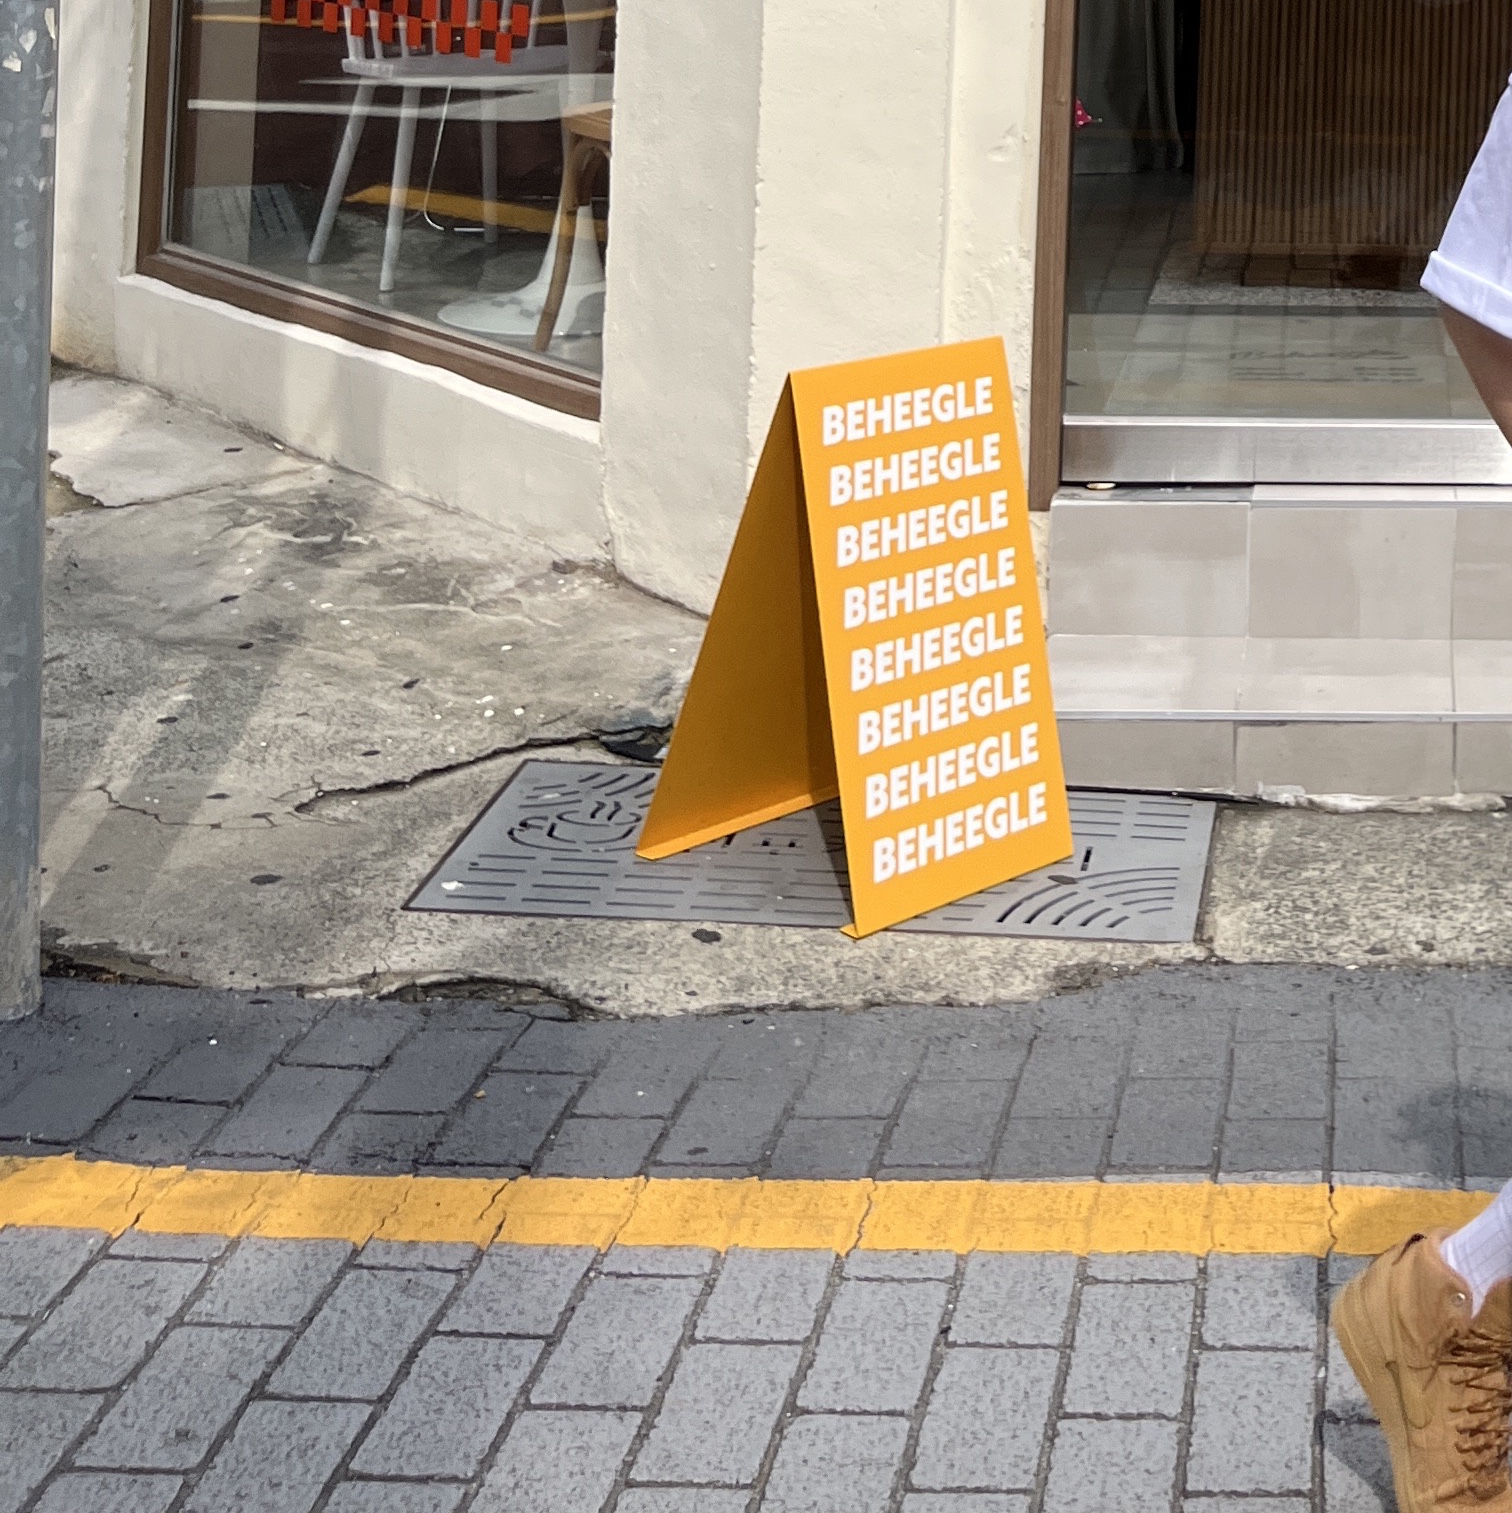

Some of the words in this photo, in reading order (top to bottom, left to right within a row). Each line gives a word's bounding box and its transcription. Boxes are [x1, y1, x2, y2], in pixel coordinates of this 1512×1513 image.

[823, 376, 994, 446] BEHEEGLE
[830, 433, 1002, 506] BEHEEGLE
[837, 490, 1009, 567] BEHEEGLE
[844, 548, 1016, 629] BEHEEGLE
[851, 606, 1024, 692] BEHEEGLE
[858, 664, 1032, 755] BEHEEGLE
[866, 723, 1040, 818] BEHEEGLE
[873, 783, 1048, 883] BEHEEGLE
